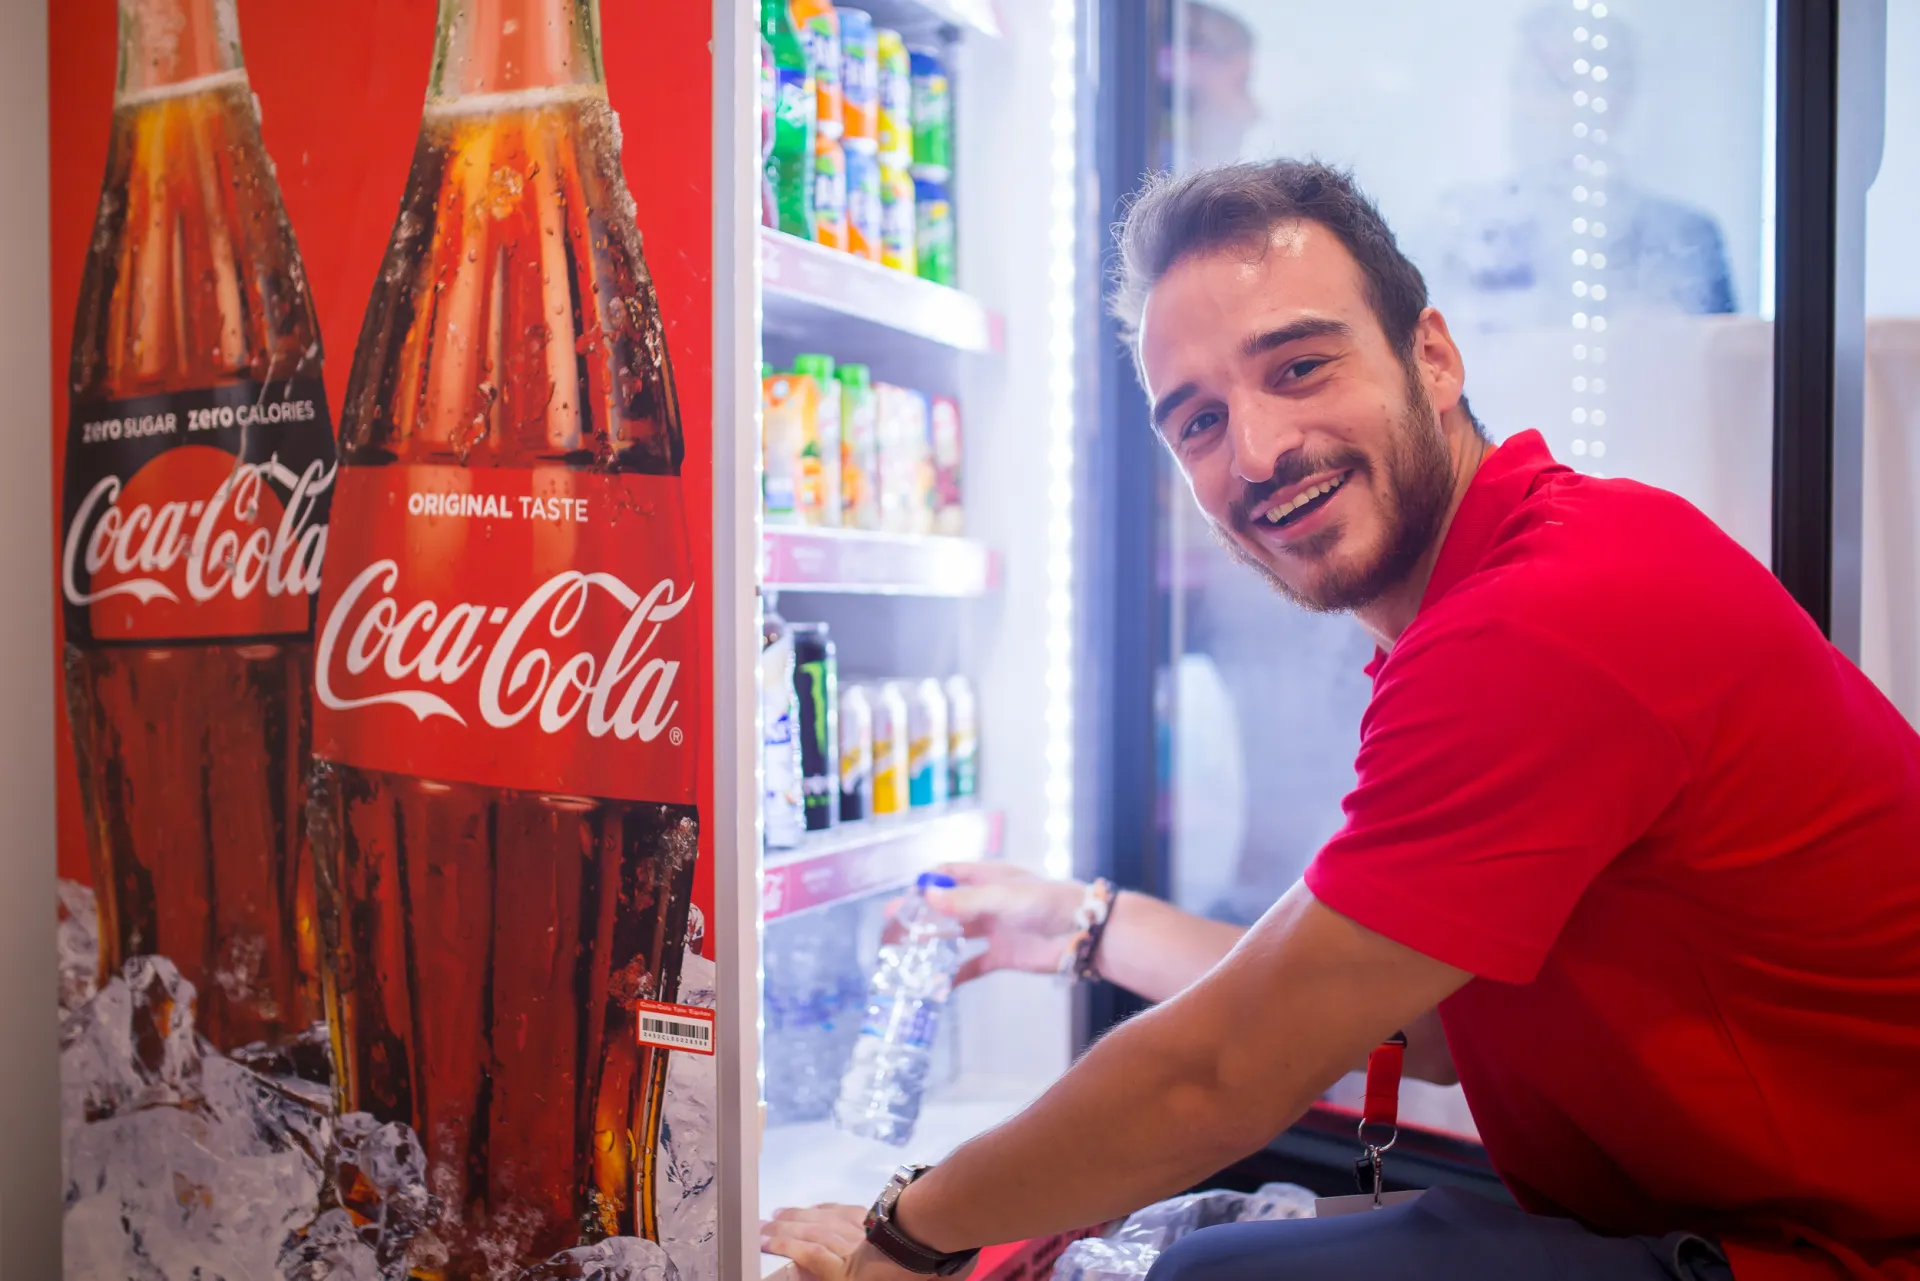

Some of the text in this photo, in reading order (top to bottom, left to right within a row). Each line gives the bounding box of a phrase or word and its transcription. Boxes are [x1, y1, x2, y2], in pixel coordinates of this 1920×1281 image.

[82, 400, 316, 443] zero SUGAR zero CALORIES
[62, 458, 338, 607] Coca-Cola
[408, 492, 589, 523] ORIGINAL TASTE
[314, 558, 695, 743] Coca-Cola
